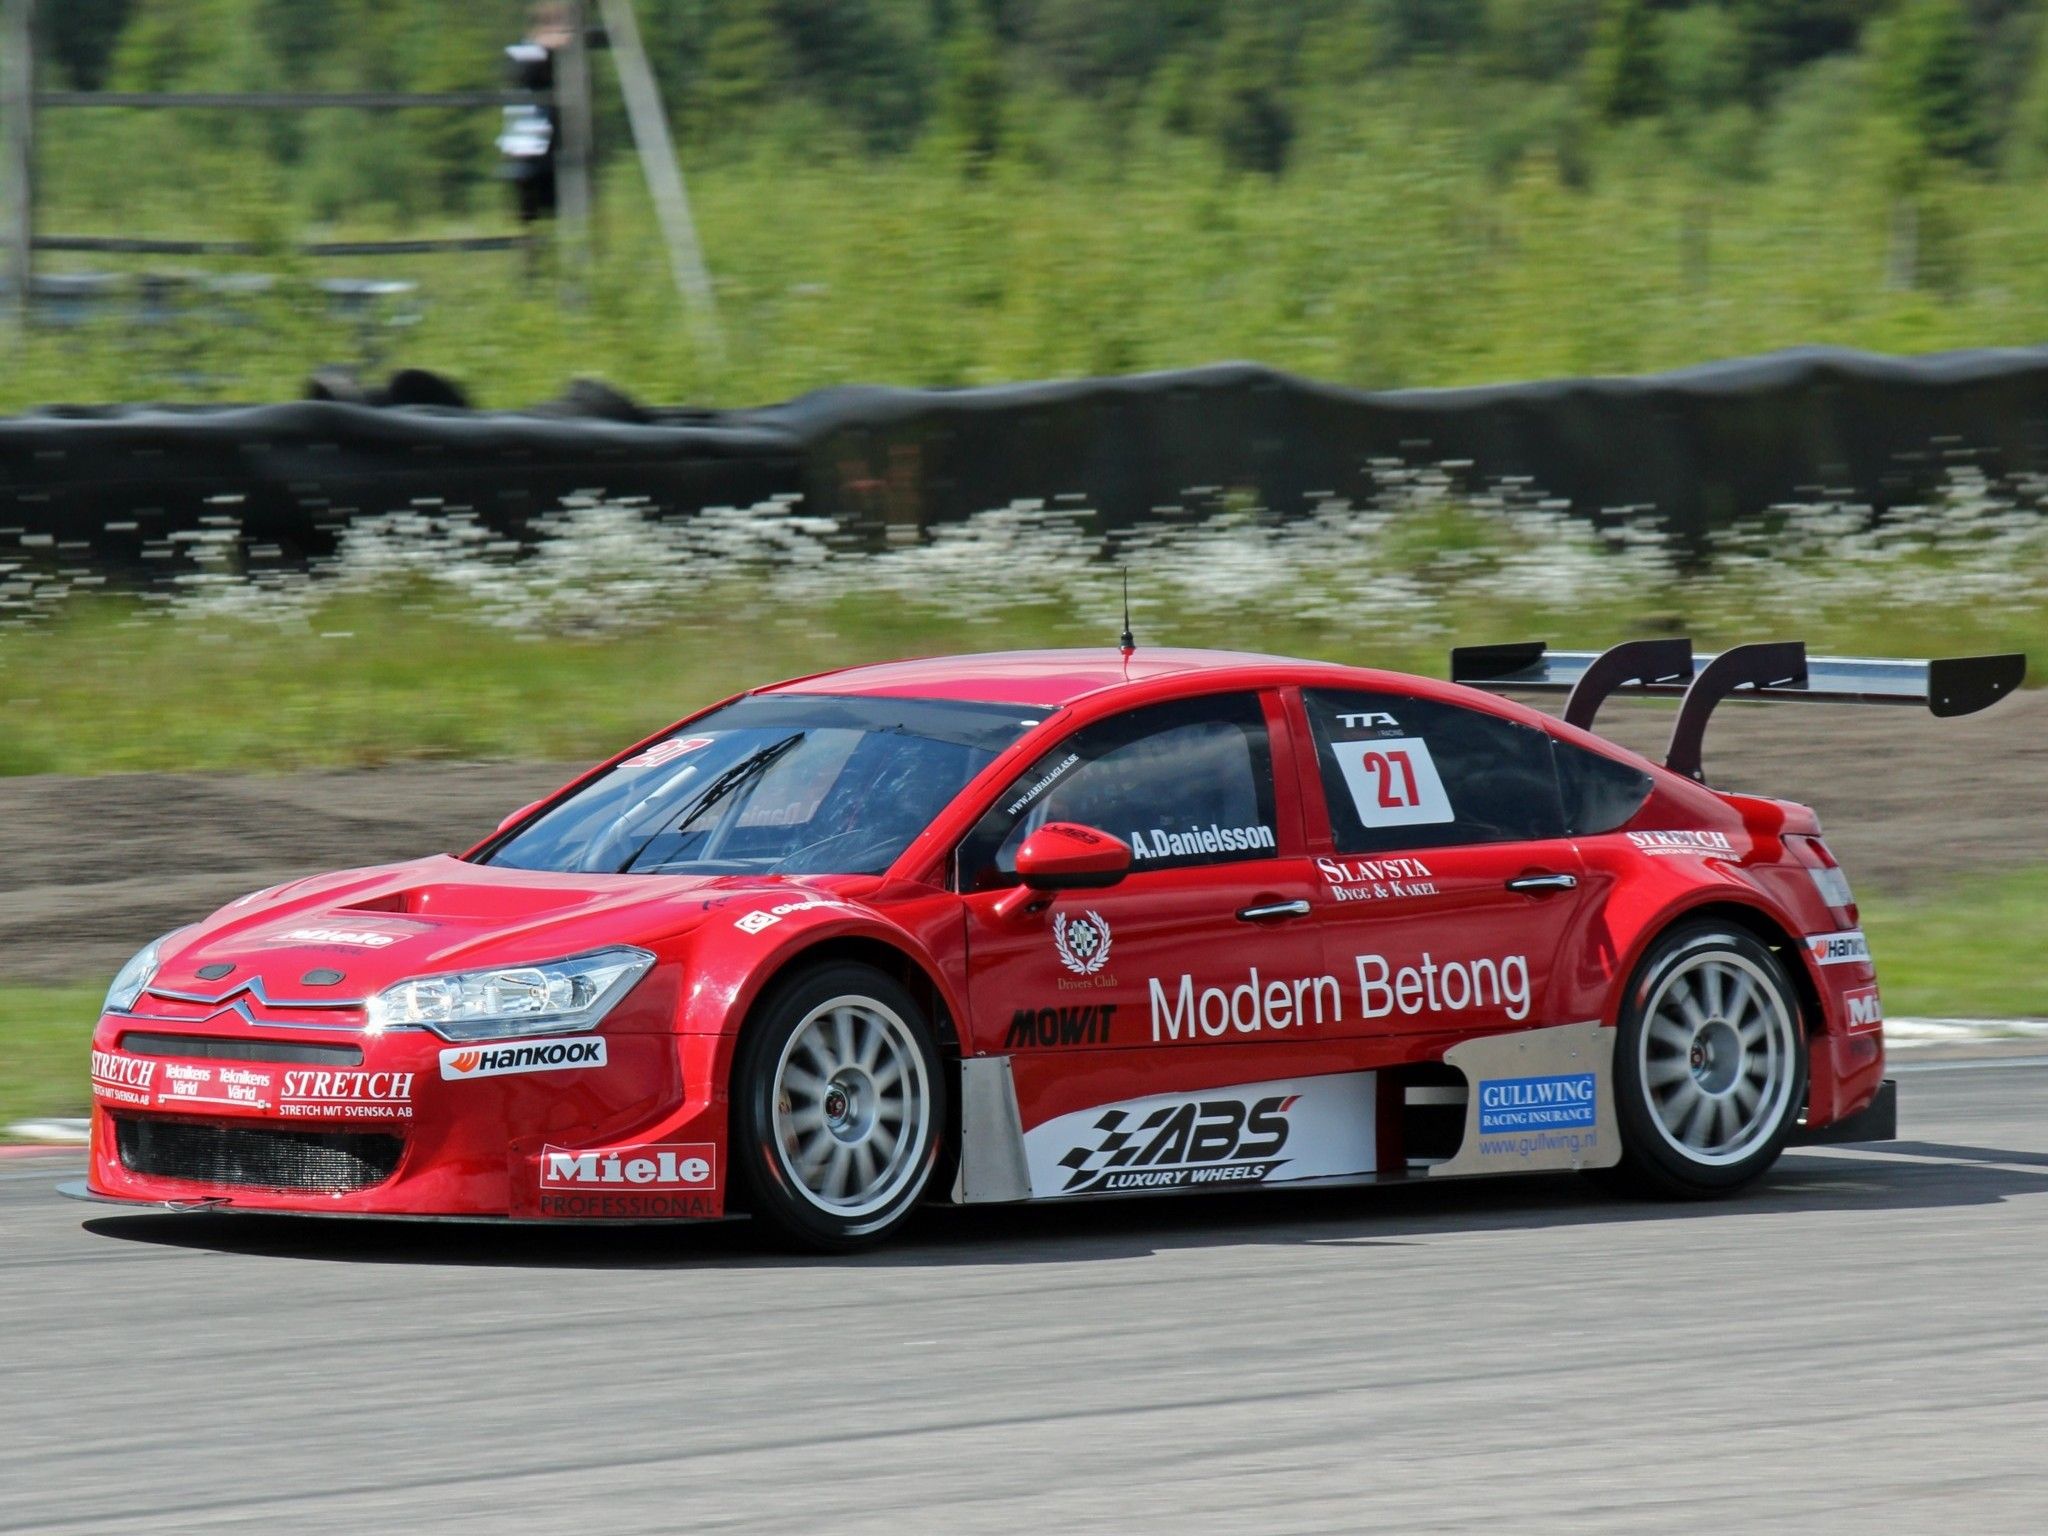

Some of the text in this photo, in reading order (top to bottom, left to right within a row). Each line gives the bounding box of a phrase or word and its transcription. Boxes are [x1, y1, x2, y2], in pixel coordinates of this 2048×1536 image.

[1362, 750, 1420, 808] 27
[1131, 824, 1276, 860] A.Danielsson
[1626, 830, 1732, 849] STRETCH
[1373, 883, 1389, 898] &
[1057, 975, 1118, 990] Drivers Club
[1149, 953, 1531, 1042] Modern Betong
[1003, 1004, 1118, 1049] MOWIT
[91, 1051, 156, 1087] STRETCH
[165, 1064, 212, 1081] Teknikens
[219, 1068, 271, 1087] Teknikens
[173, 1080, 198, 1096] Värld
[228, 1085, 257, 1100] Värld
[281, 1070, 415, 1098] STRETCH
[1483, 1079, 1593, 1108] GULLWING
[139, 1094, 150, 1106] AB
[280, 1104, 413, 1118] STRETCH M/T SVENSKA AB
[1483, 1107, 1593, 1127] RACING INSURANCE
[1130, 1095, 1303, 1166] ABS
[1480, 1129, 1598, 1157] www.gullwing.nl
[547, 1152, 710, 1184] Miele
[1105, 1164, 1266, 1189] LUXURY WHEELS
[540, 1194, 714, 1217] PROFESSIONAL
